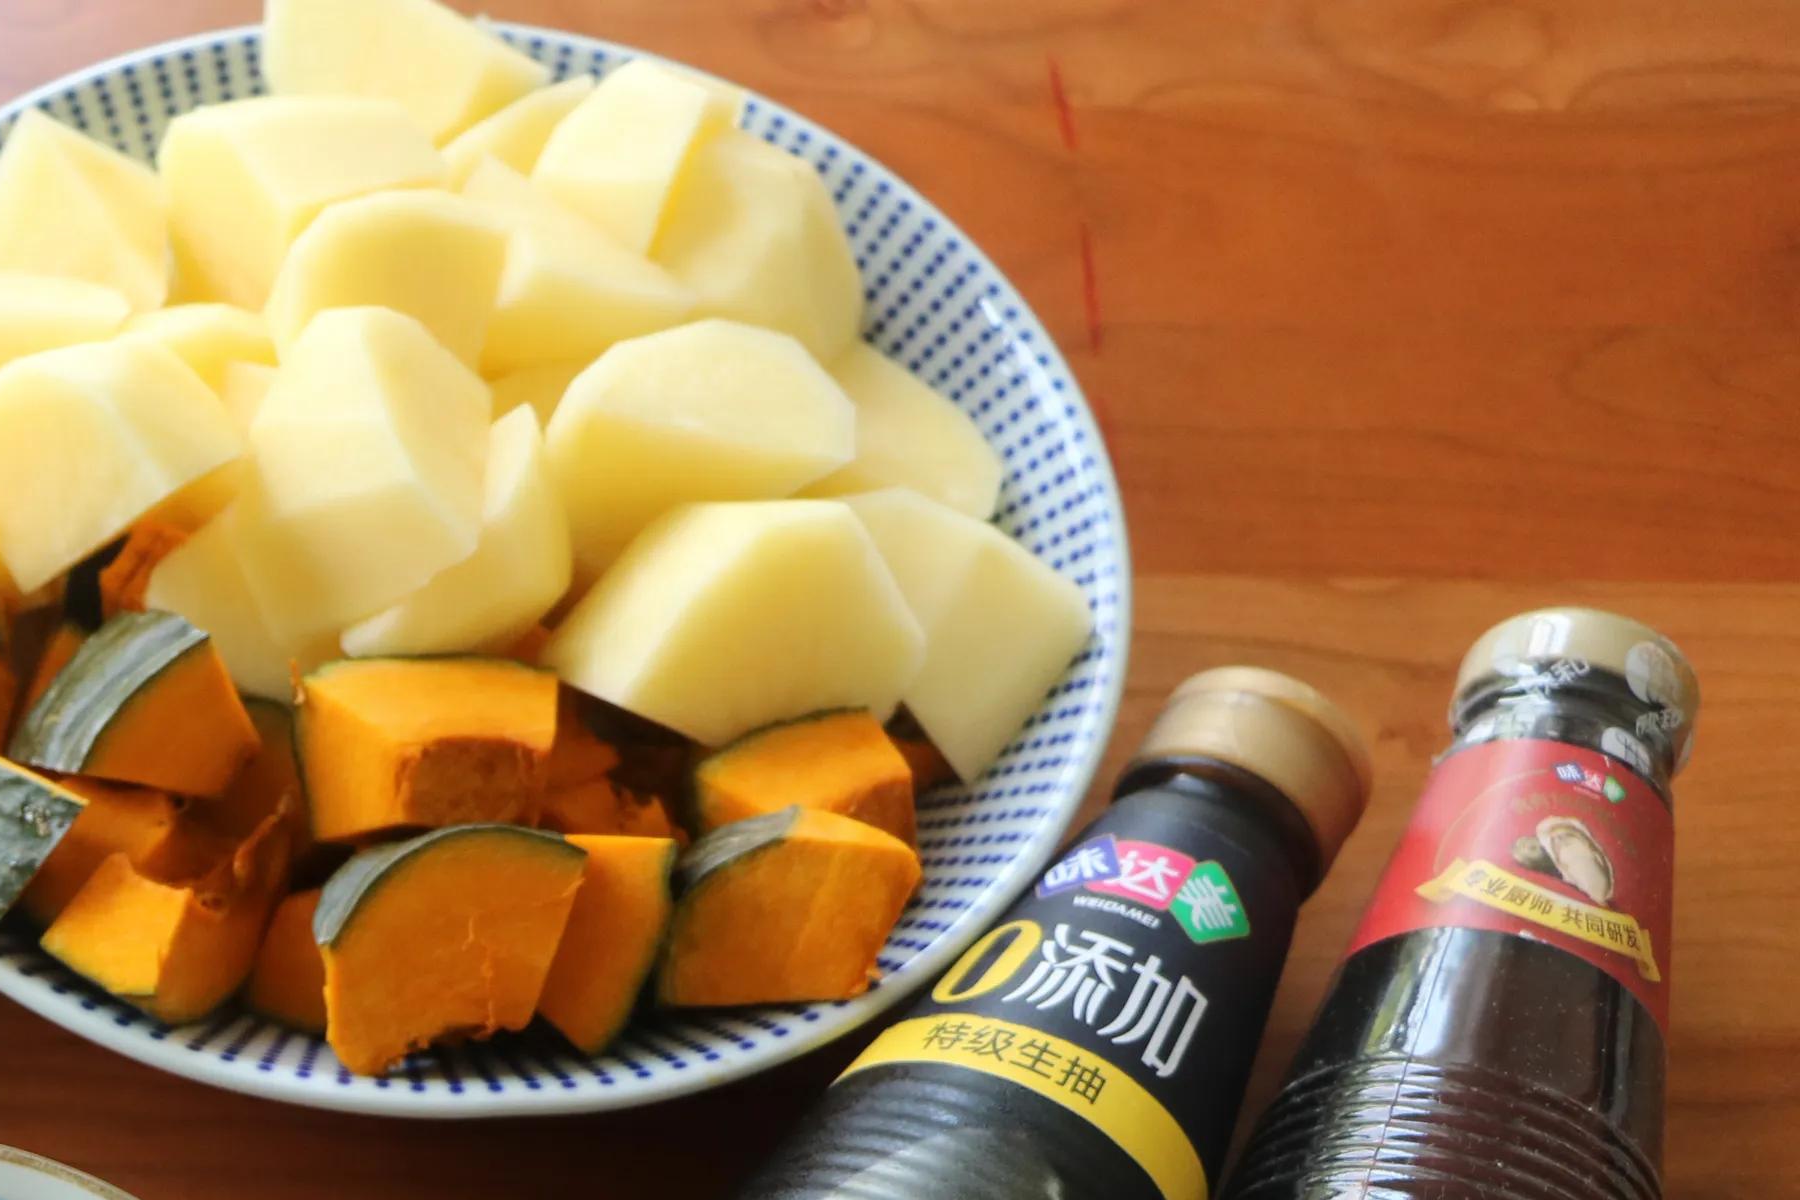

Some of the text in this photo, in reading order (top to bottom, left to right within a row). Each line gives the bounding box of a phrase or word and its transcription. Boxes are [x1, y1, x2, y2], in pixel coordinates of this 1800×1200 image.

[1043, 847, 1237, 931] 味达美
[1073, 895, 1161, 929] WEIDAMEI
[1561, 905, 1641, 951] 共同研发
[932, 919, 1209, 1079] 0添加
[921, 1020, 1108, 1105] 特级生抽
